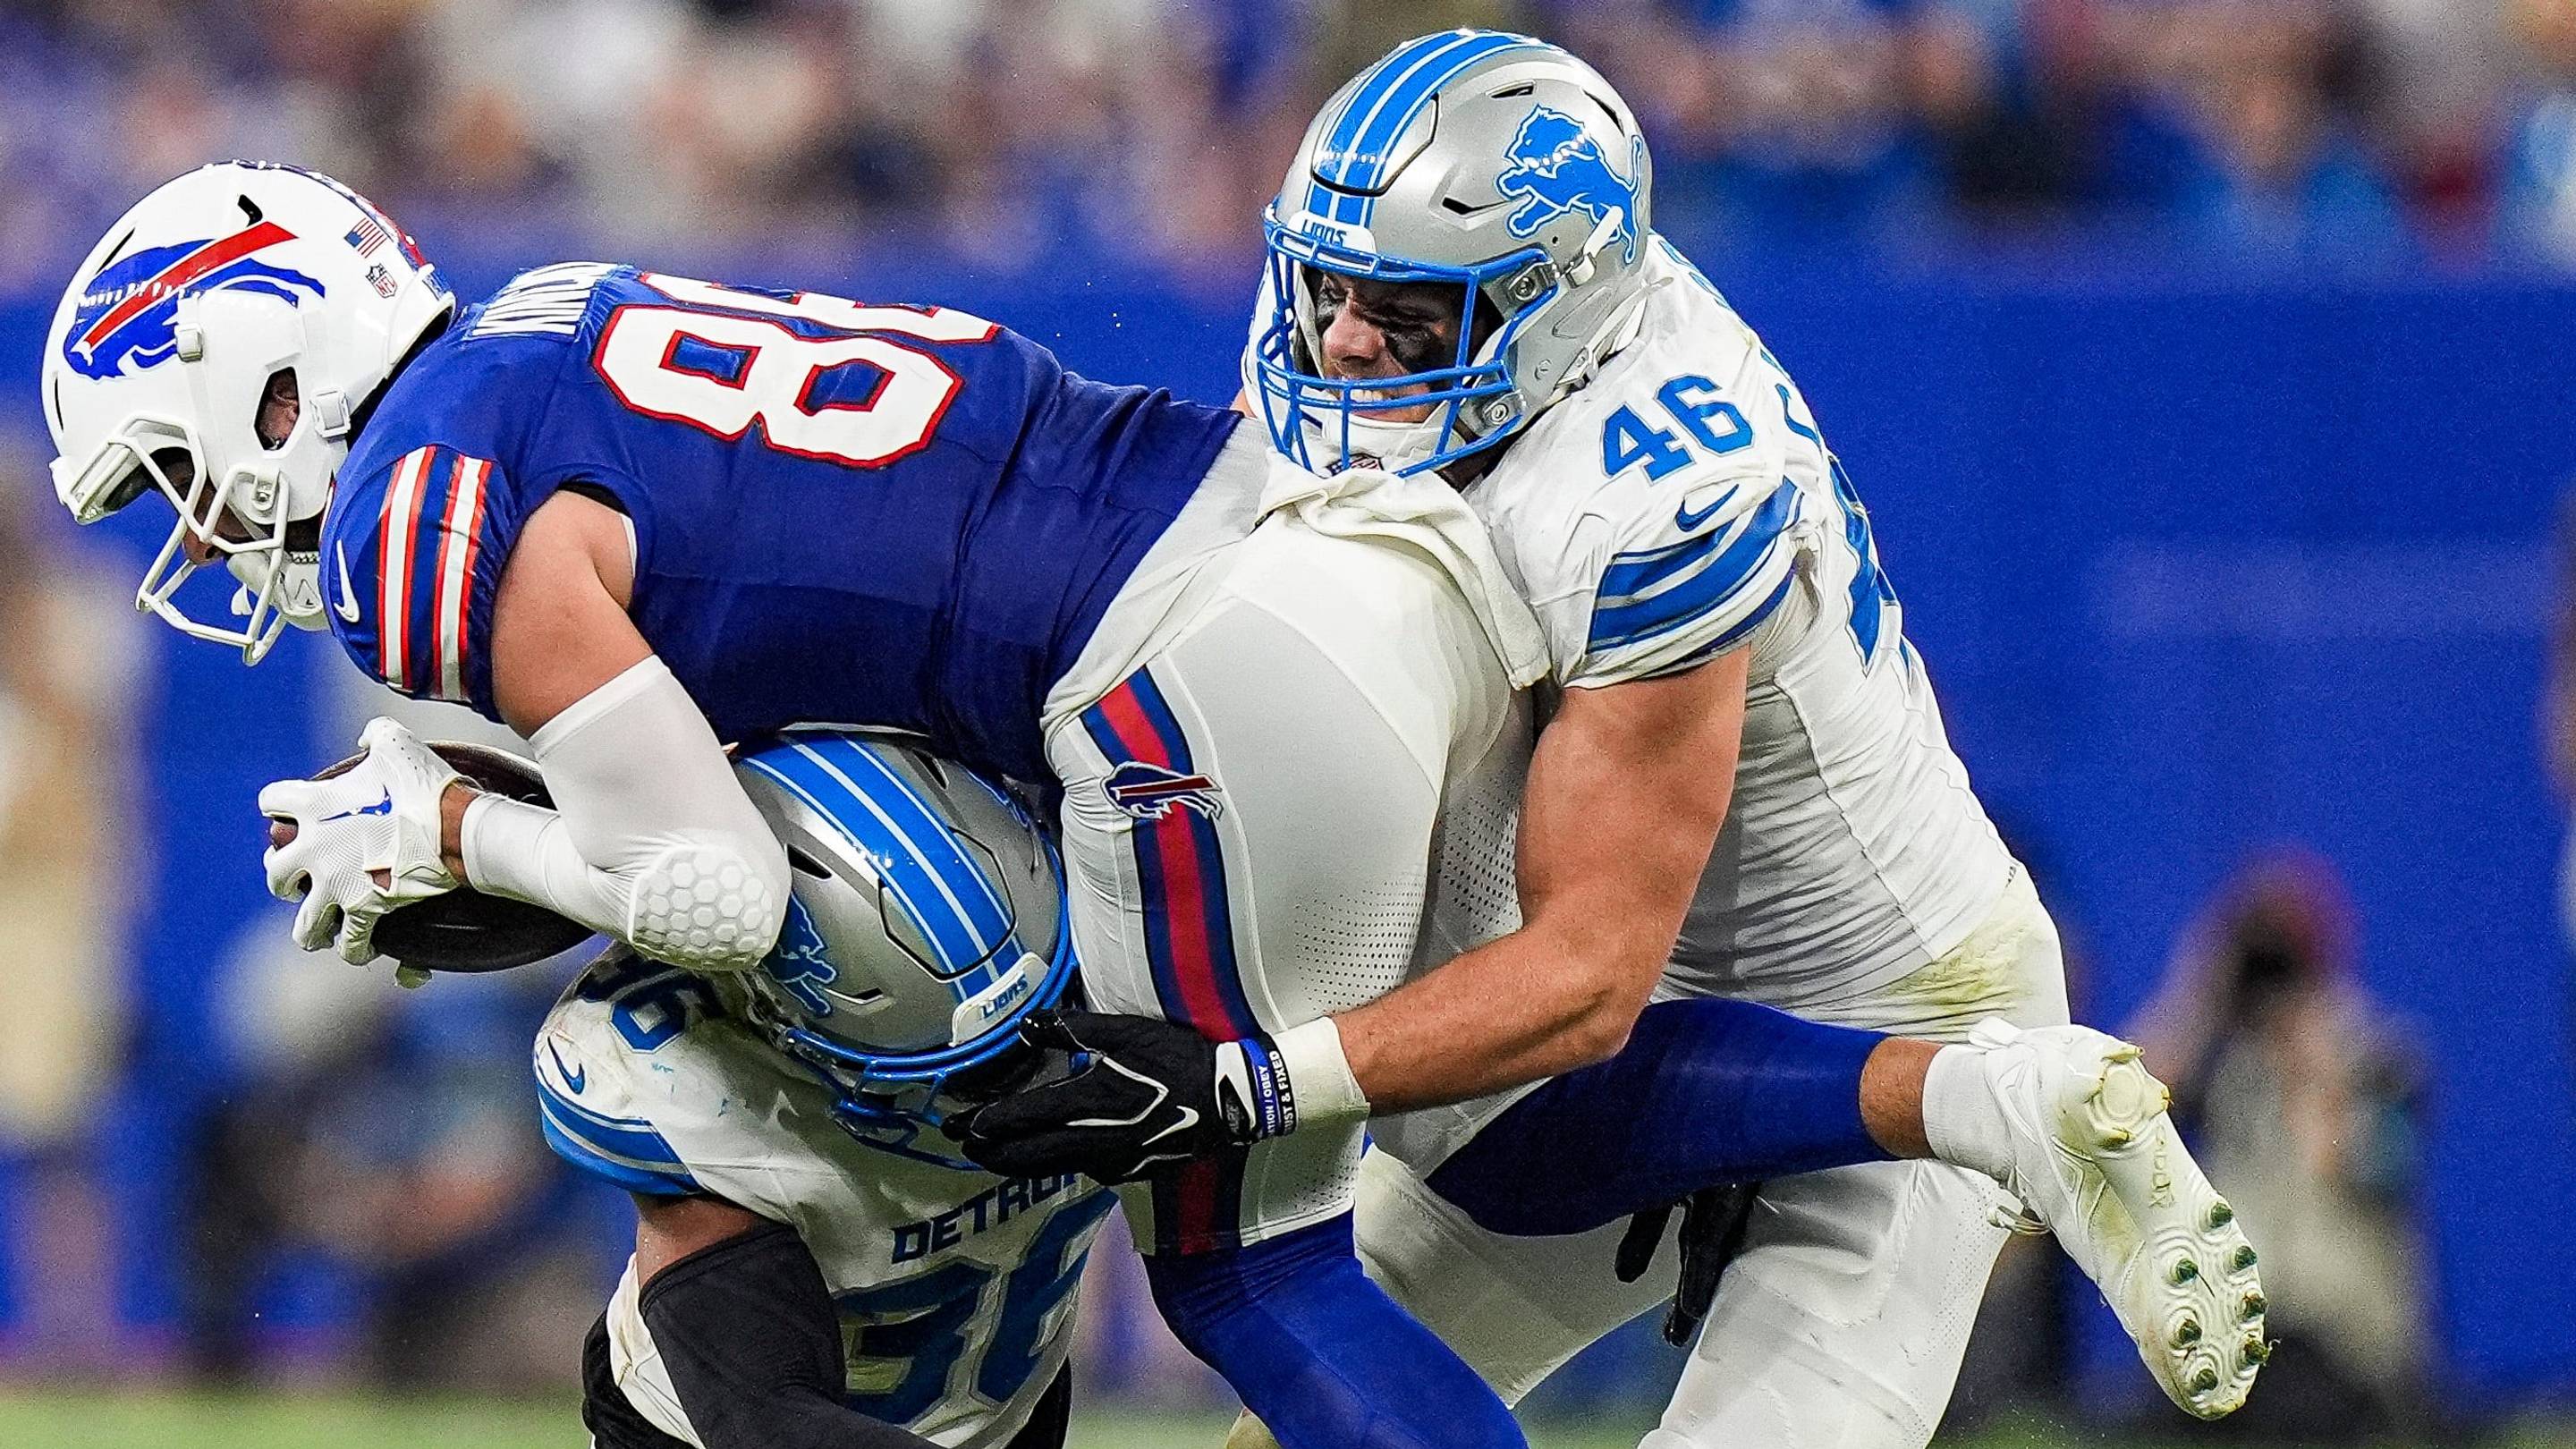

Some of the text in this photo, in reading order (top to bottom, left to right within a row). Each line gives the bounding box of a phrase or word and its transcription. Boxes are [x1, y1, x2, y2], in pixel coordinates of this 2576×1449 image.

[1600, 373, 1754, 486] 46
[981, 973, 1030, 1020] LIONS
[1258, 1065, 1273, 1098] OBEY
[1268, 1050, 1294, 1131] UST & FIXED
[890, 1173, 1075, 1265] DETRO
